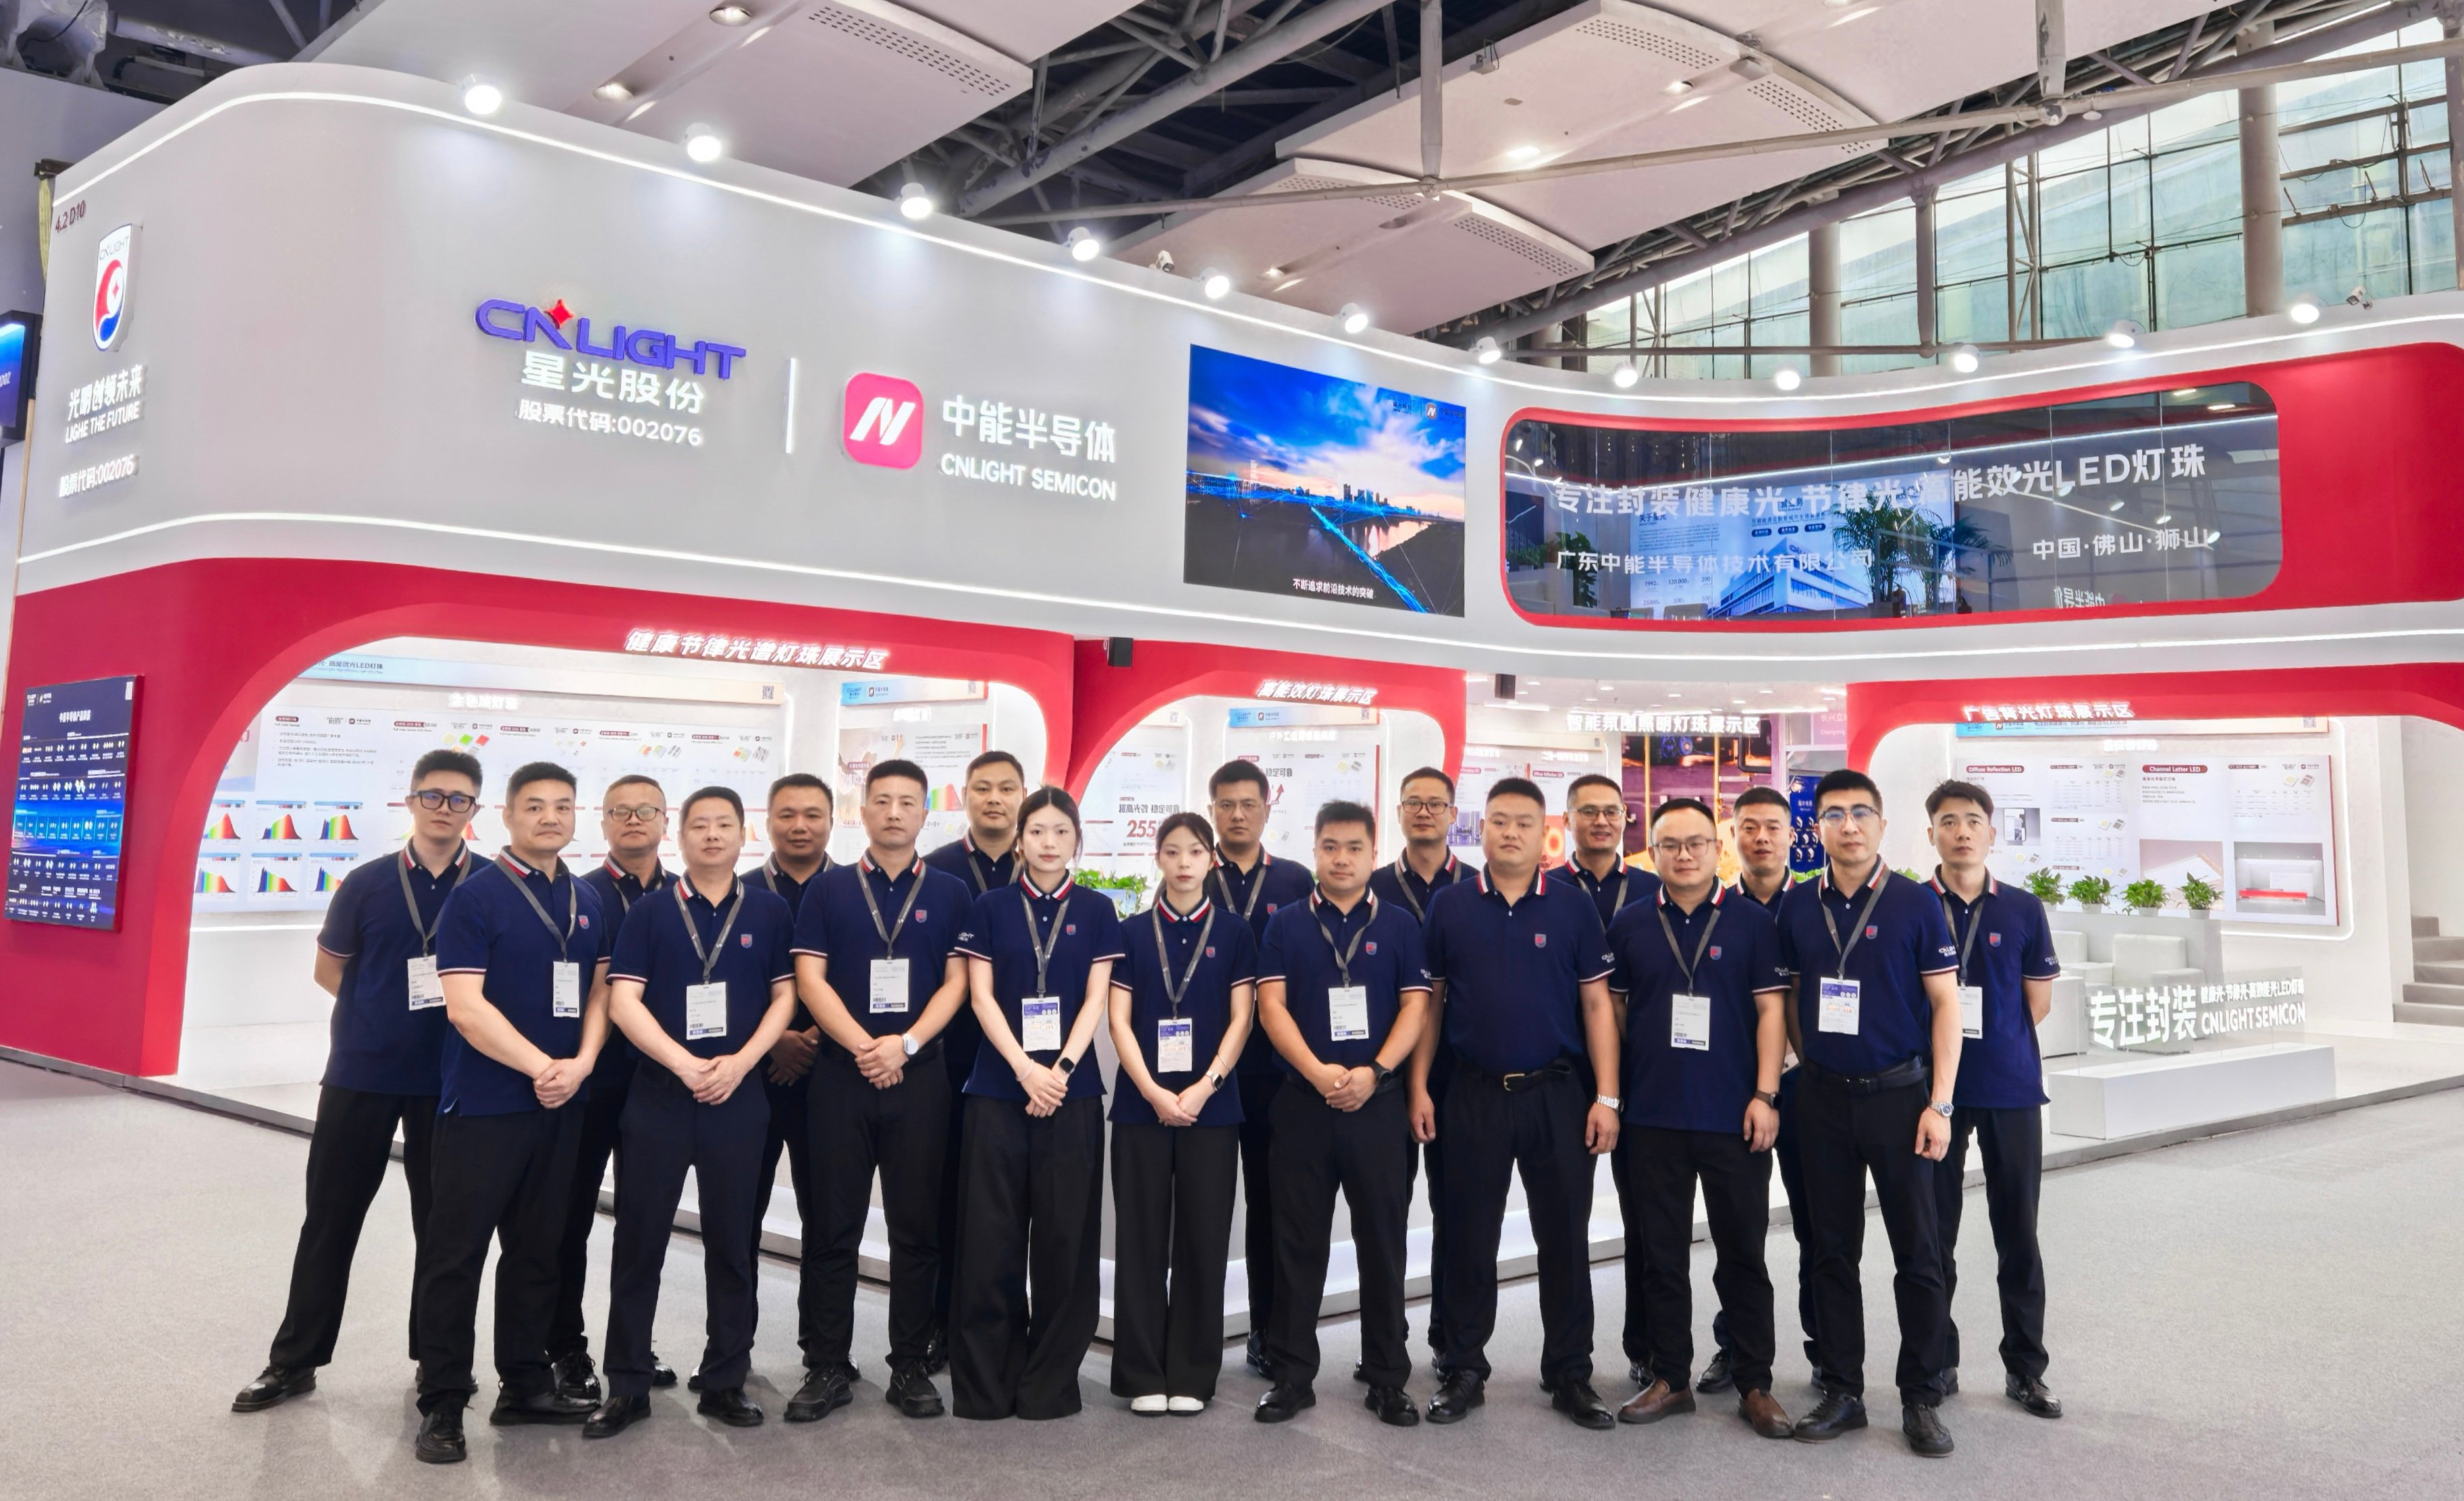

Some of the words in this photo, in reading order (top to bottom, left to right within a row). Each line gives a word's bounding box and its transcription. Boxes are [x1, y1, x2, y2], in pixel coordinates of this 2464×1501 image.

[55, 211, 68, 234] 4.2
[70, 200, 86, 225] D10
[475, 298, 747, 380] CNLIGHT
[521, 350, 704, 414] 星光股份
[90, 412, 105, 435] THE
[107, 401, 140, 429] FUTURE
[518, 399, 703, 447] 股票代码:002076
[942, 395, 1117, 464] 中能半导体
[941, 454, 1026, 487] CNLIGHT
[1031, 468, 1117, 501] SEMICON
[1557, 547, 1873, 576] 广东中能半导体技术有限公司
[625, 628, 890, 670] 健康节律光谱灯珠展示区
[1256, 680, 1378, 705] 高能效灯珠展示区
[1566, 714, 1761, 734] 智能氛围照明灯珠展示区
[1963, 701, 2135, 721] 广告背光灯珠展示区
[1127, 819, 1157, 838] 255
[2090, 984, 2198, 1049] 专注封装
[2201, 1008, 2255, 1035] CNLIGHT
[2255, 1001, 2306, 1029] SEMICON
